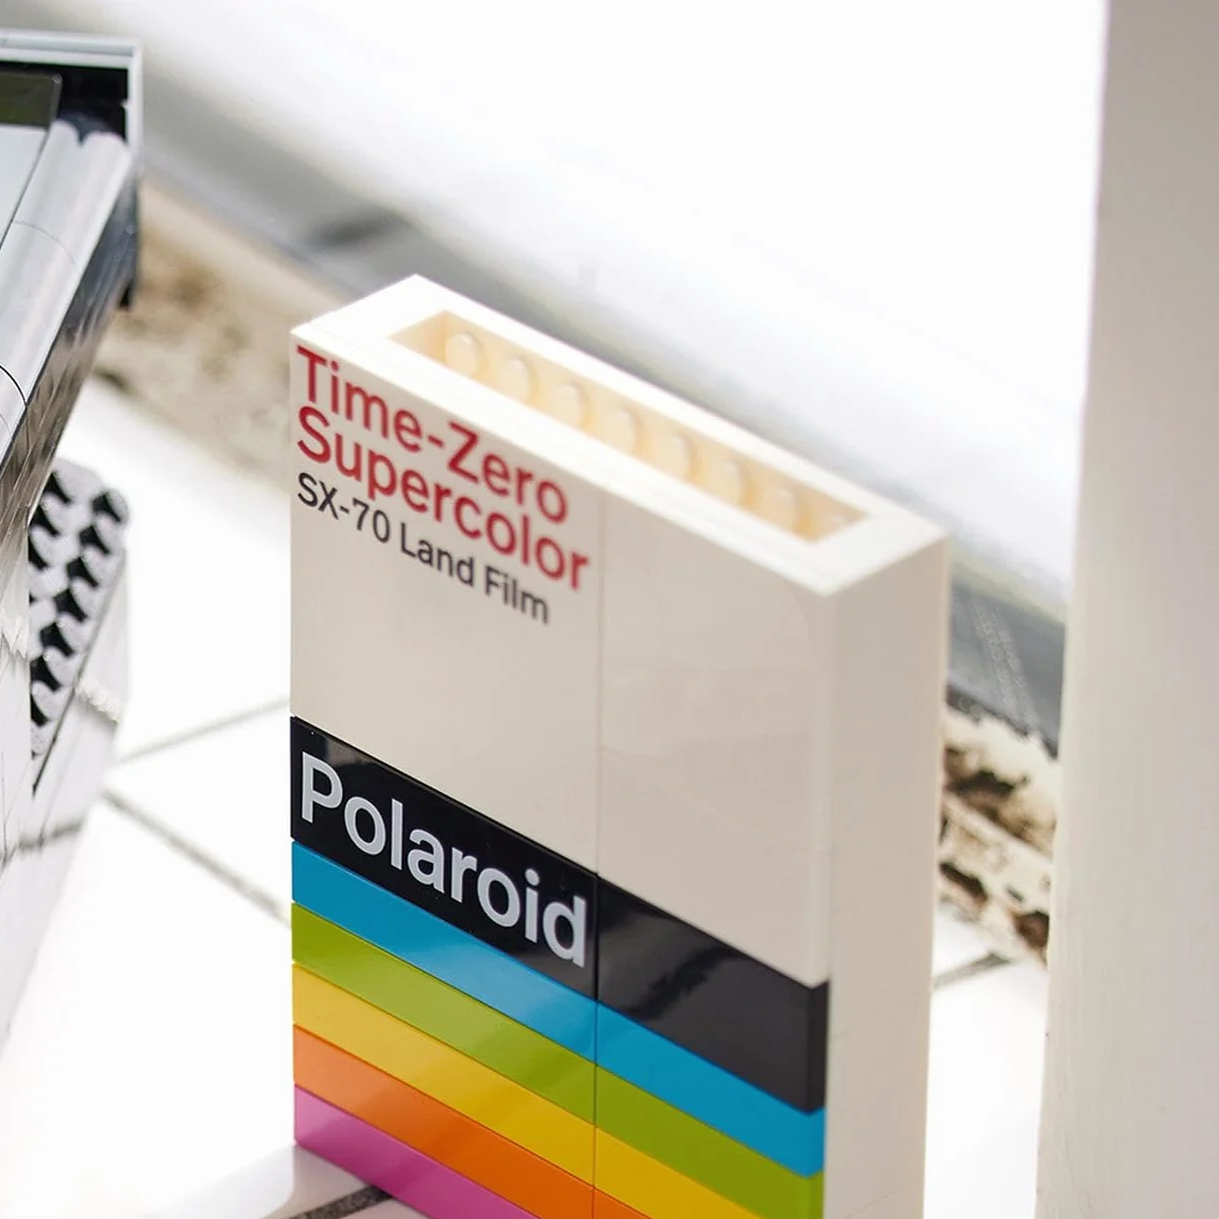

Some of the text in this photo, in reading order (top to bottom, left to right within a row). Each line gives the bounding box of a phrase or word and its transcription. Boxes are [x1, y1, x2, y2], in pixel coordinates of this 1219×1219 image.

[296, 344, 568, 524] Time-Zero
[297, 405, 589, 590] Supercolor
[297, 472, 549, 625] SX-70 Land Film
[301, 751, 587, 968] Polaroid
